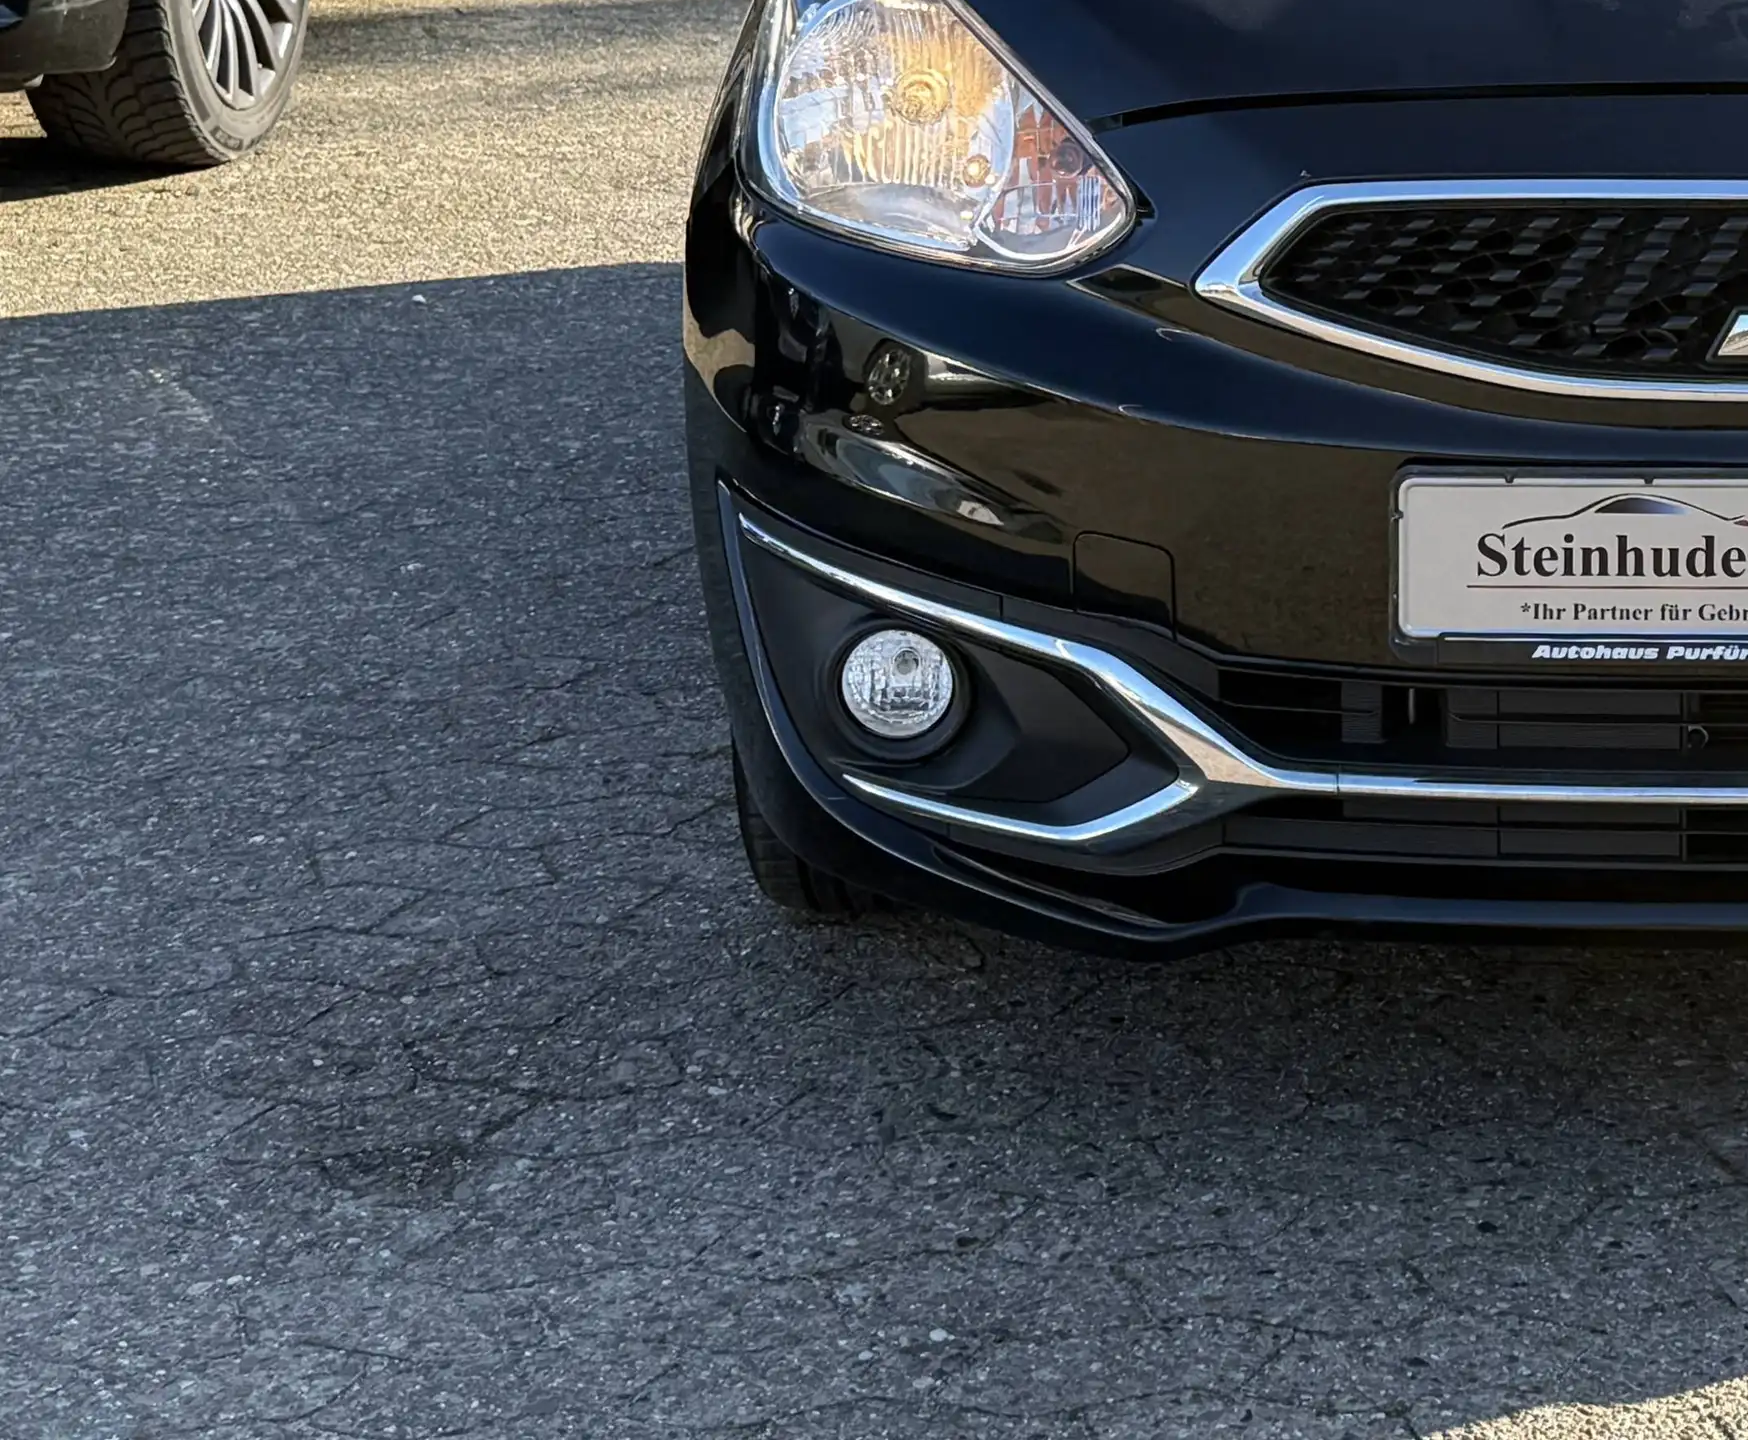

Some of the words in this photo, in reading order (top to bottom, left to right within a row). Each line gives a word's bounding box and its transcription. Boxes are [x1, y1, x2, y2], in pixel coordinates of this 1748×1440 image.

[1573, 603, 1653, 621] Partner
[1660, 603, 1692, 621] für
[1532, 644, 1659, 660] Autohaus
